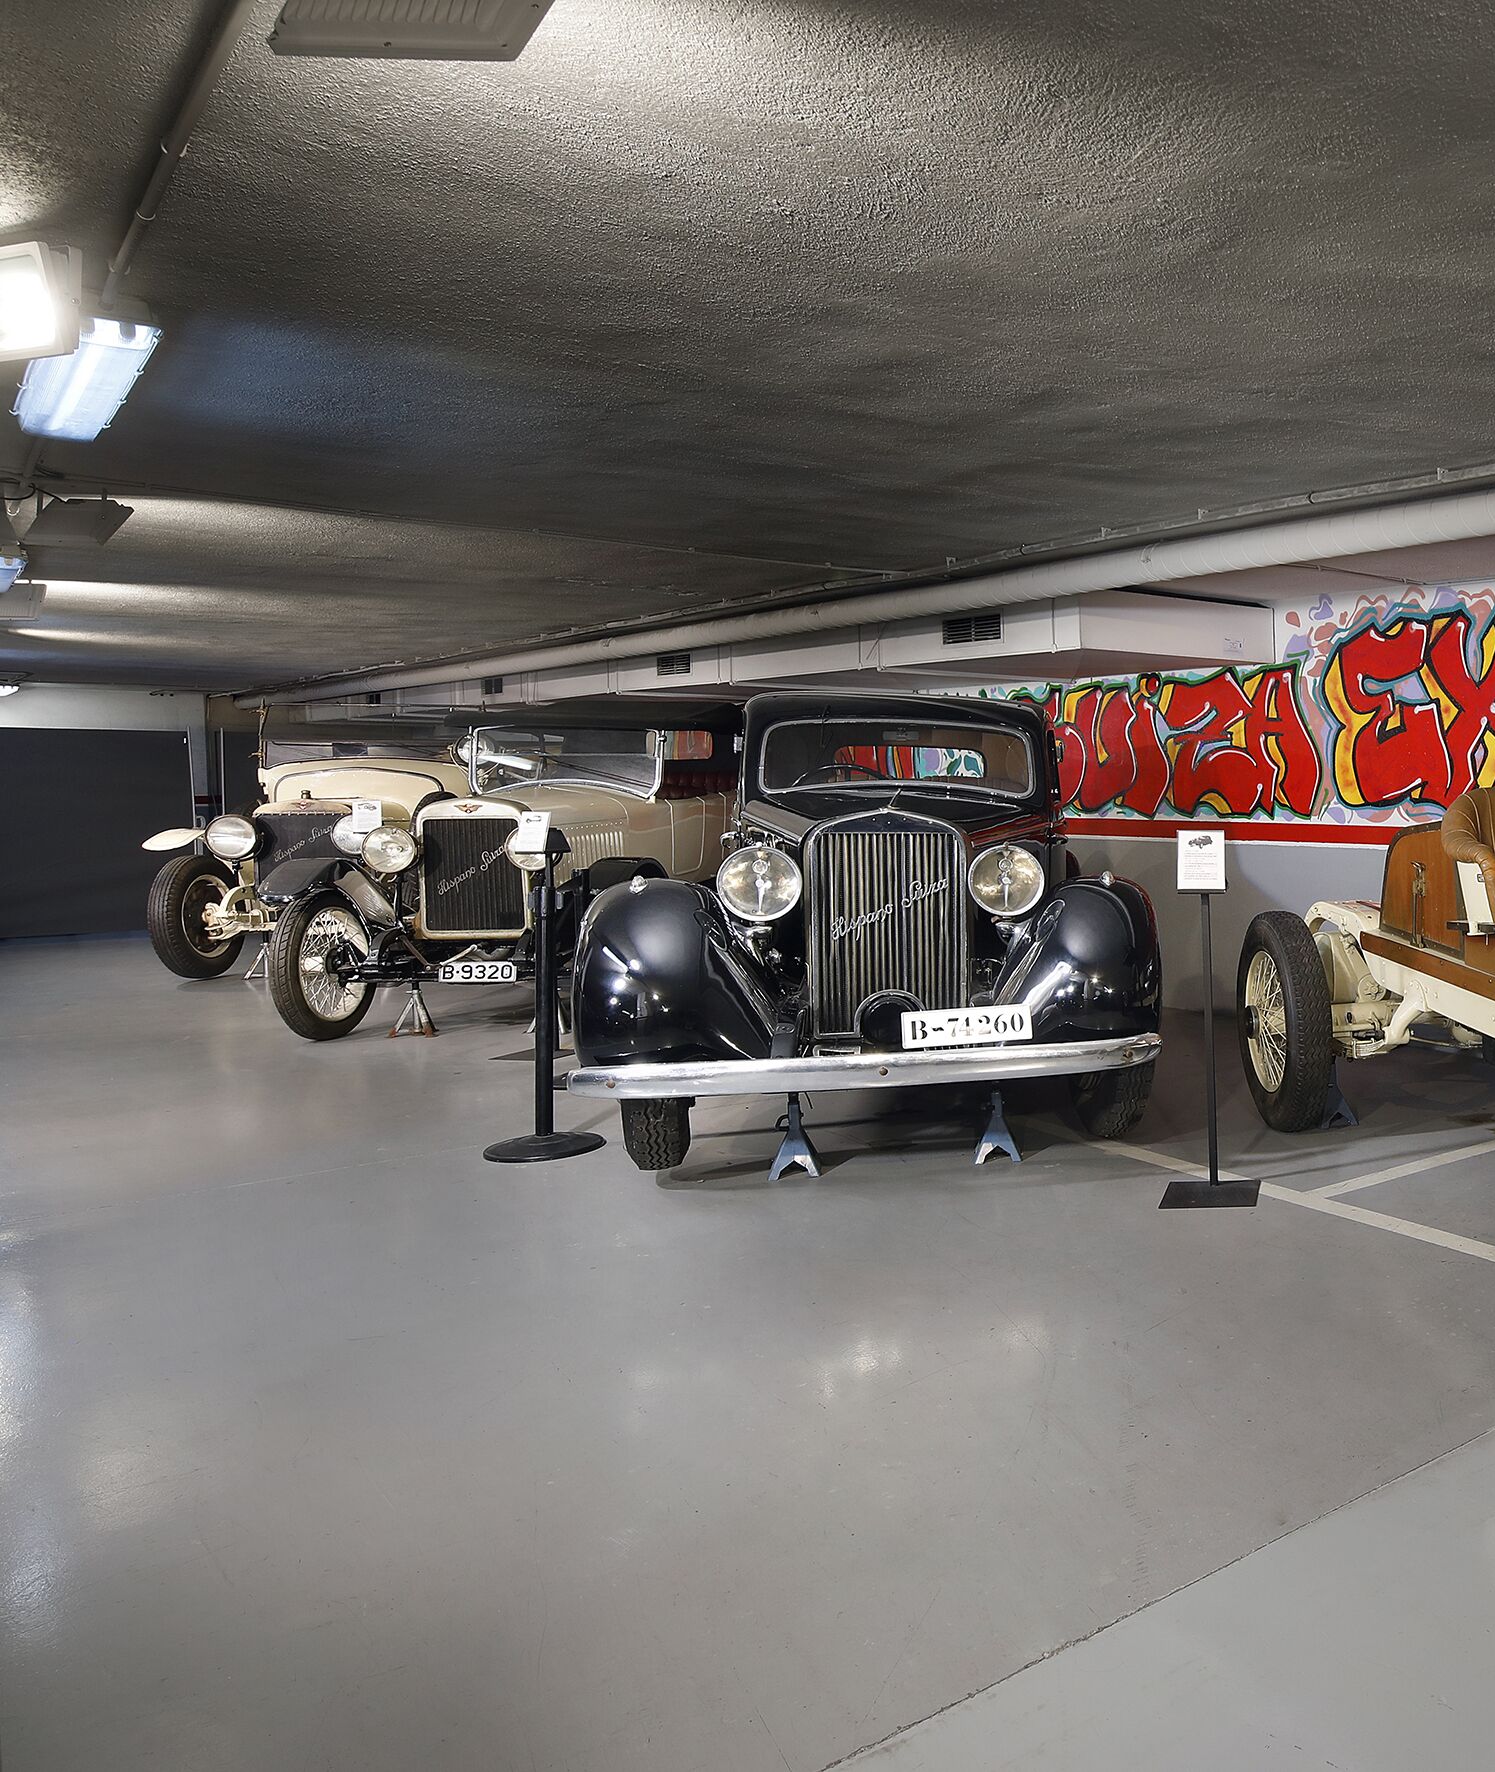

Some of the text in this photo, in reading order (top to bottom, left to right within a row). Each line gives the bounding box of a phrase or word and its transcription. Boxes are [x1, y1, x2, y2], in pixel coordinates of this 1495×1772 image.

[274, 839, 306, 862] Hispano
[437, 866, 476, 895] Hispano
[831, 878, 949, 941] Hispano Suiza
